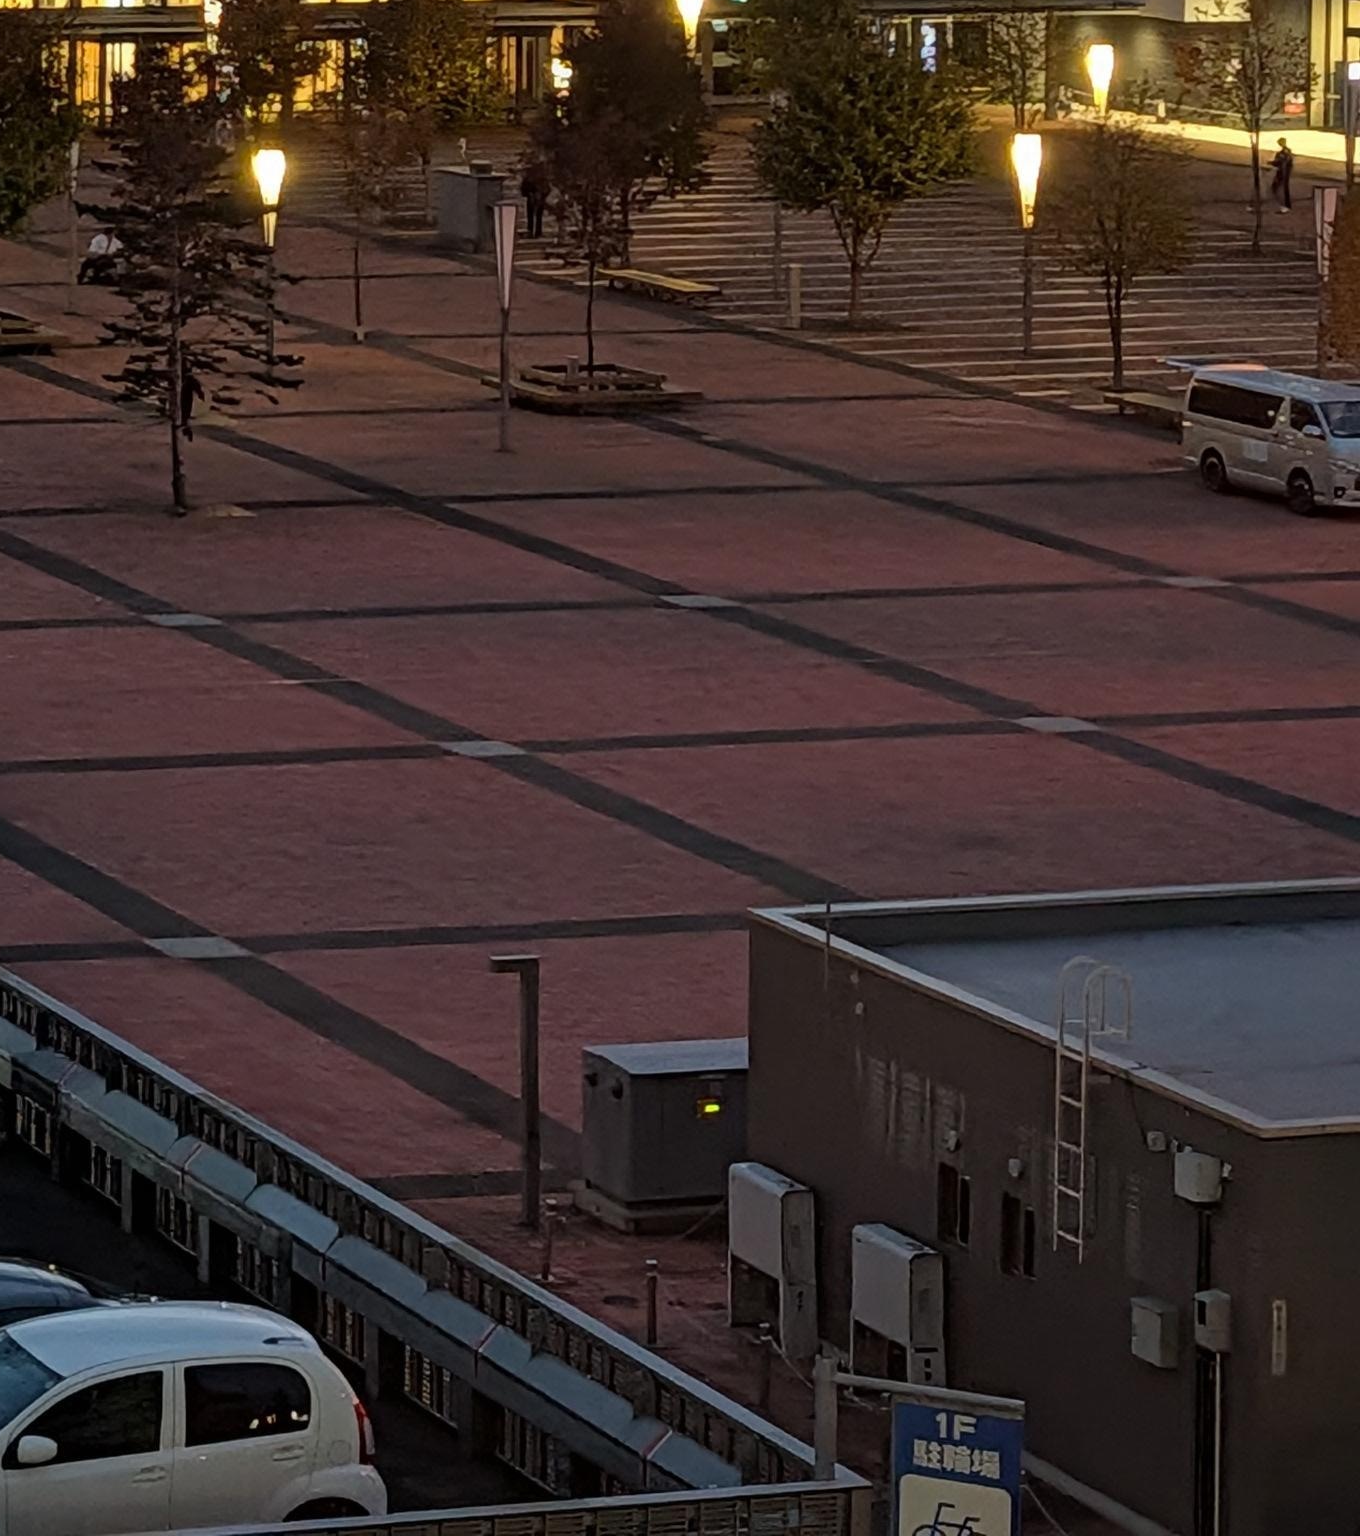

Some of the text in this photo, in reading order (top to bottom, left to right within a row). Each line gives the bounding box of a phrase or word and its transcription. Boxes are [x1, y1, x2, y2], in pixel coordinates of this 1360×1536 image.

[935, 1412, 977, 1440] 1F
[913, 1438, 1000, 1480] 駐輪場
